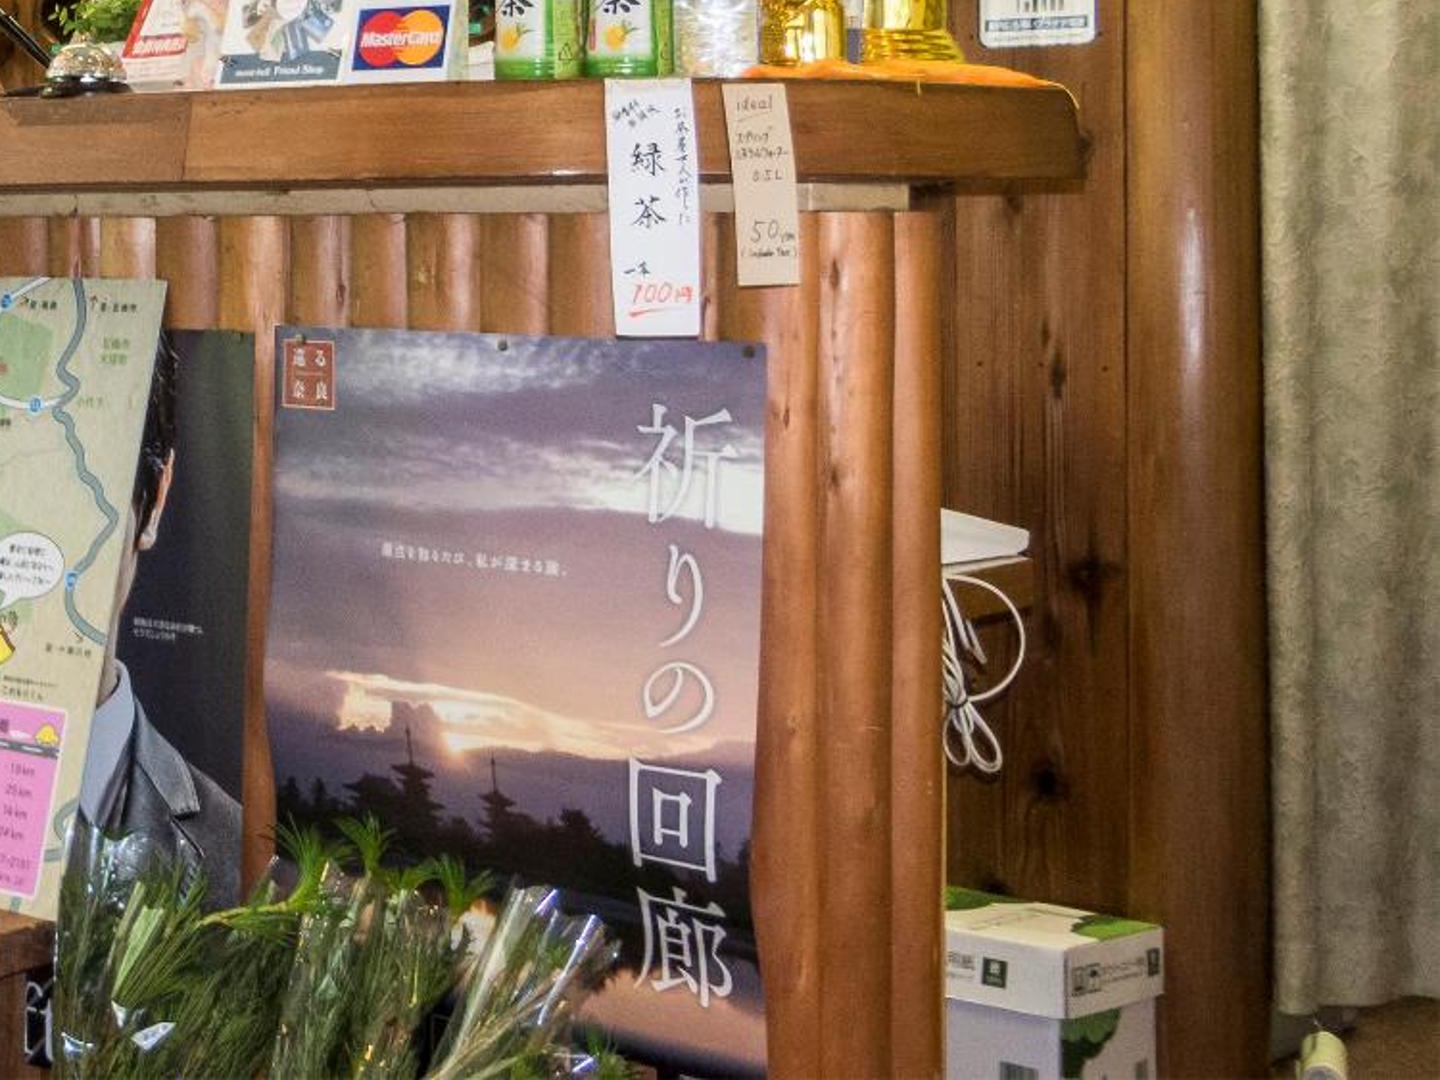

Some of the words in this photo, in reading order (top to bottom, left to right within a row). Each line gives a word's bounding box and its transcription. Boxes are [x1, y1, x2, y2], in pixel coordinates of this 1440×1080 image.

[630, 141, 667, 230] 緑茶
[631, 281, 694, 304] 100円
[627, 402, 740, 1010] 祈りの回廊
